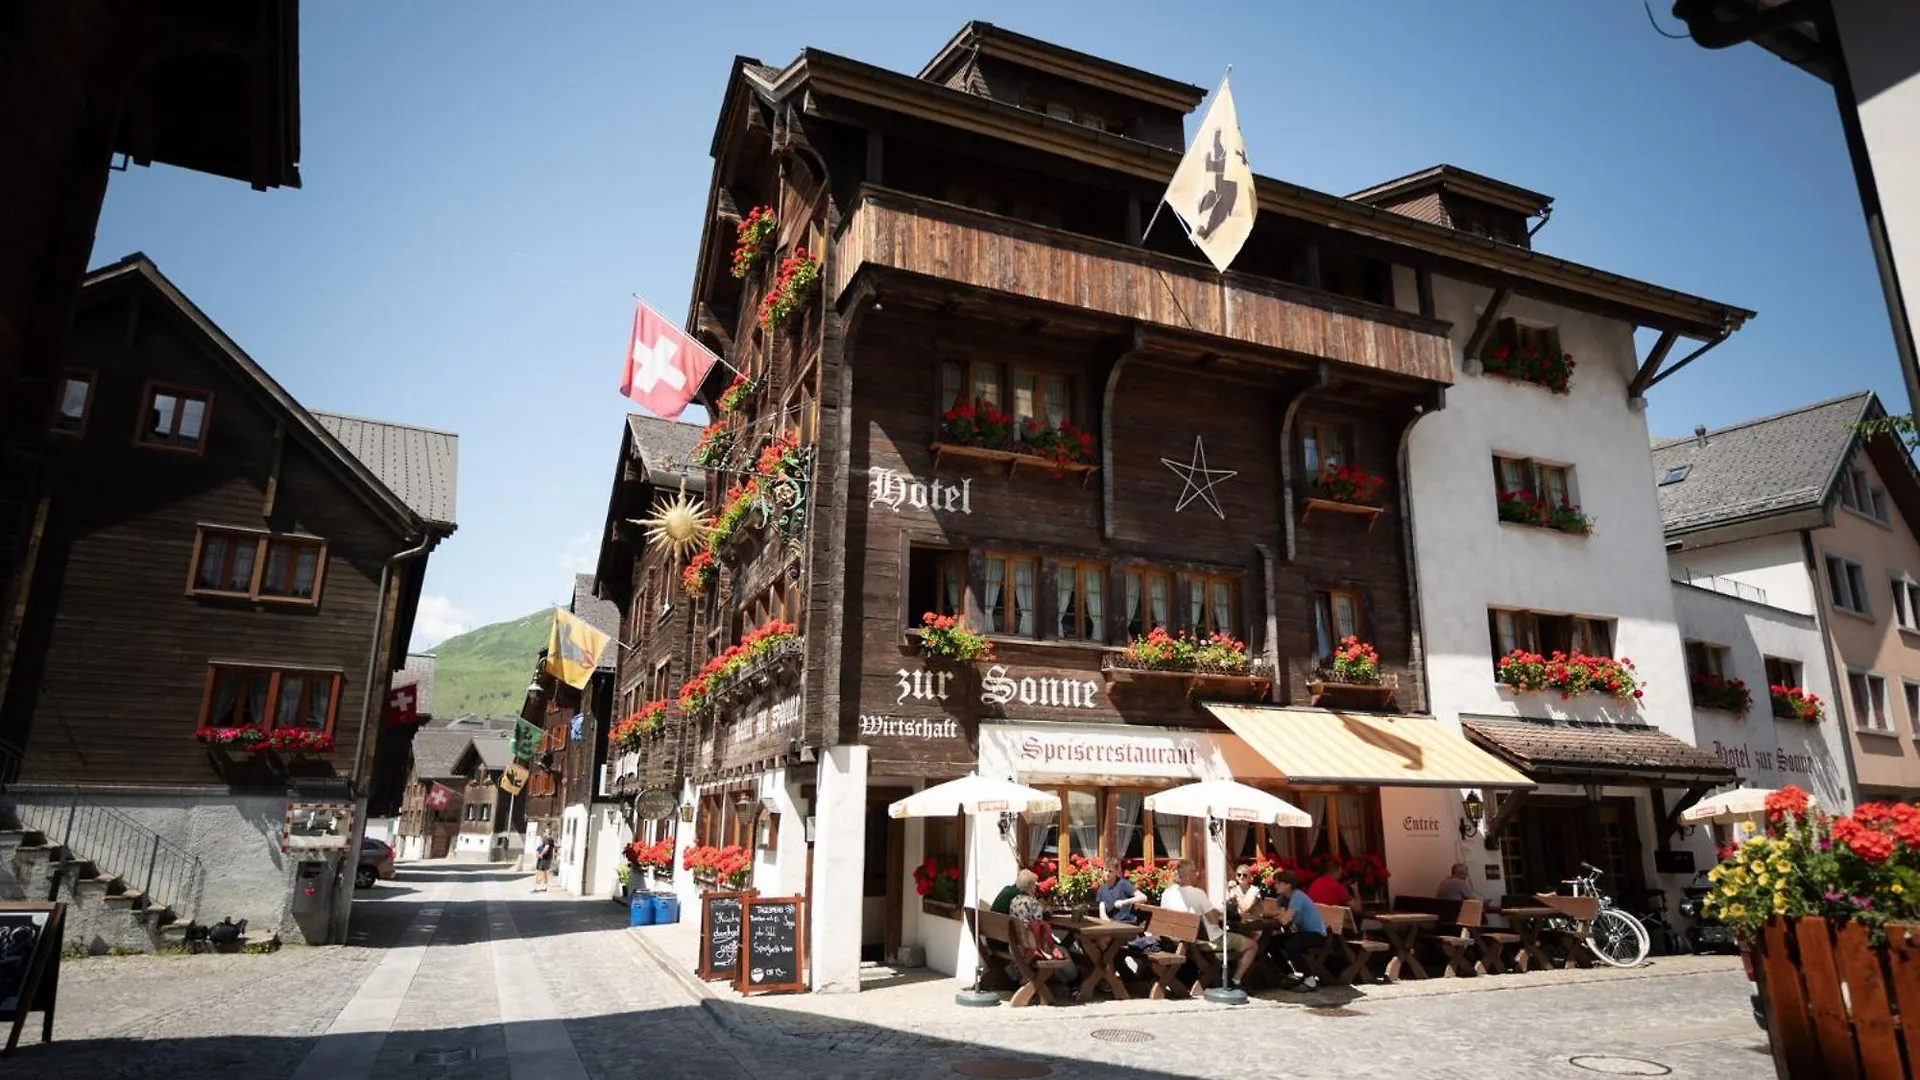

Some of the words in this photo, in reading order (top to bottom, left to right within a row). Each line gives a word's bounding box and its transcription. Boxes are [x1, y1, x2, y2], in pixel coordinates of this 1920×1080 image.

[868, 466, 972, 514] Hotel
[895, 667, 954, 706] zur
[981, 664, 1098, 708] Sonne
[859, 714, 958, 739] Wirtschaft
[1020, 736, 1197, 765] Speiserestaurant
[1712, 740, 1751, 769] Hotel
[1755, 750, 1773, 772] zur
[1775, 747, 1814, 774] Sonne
